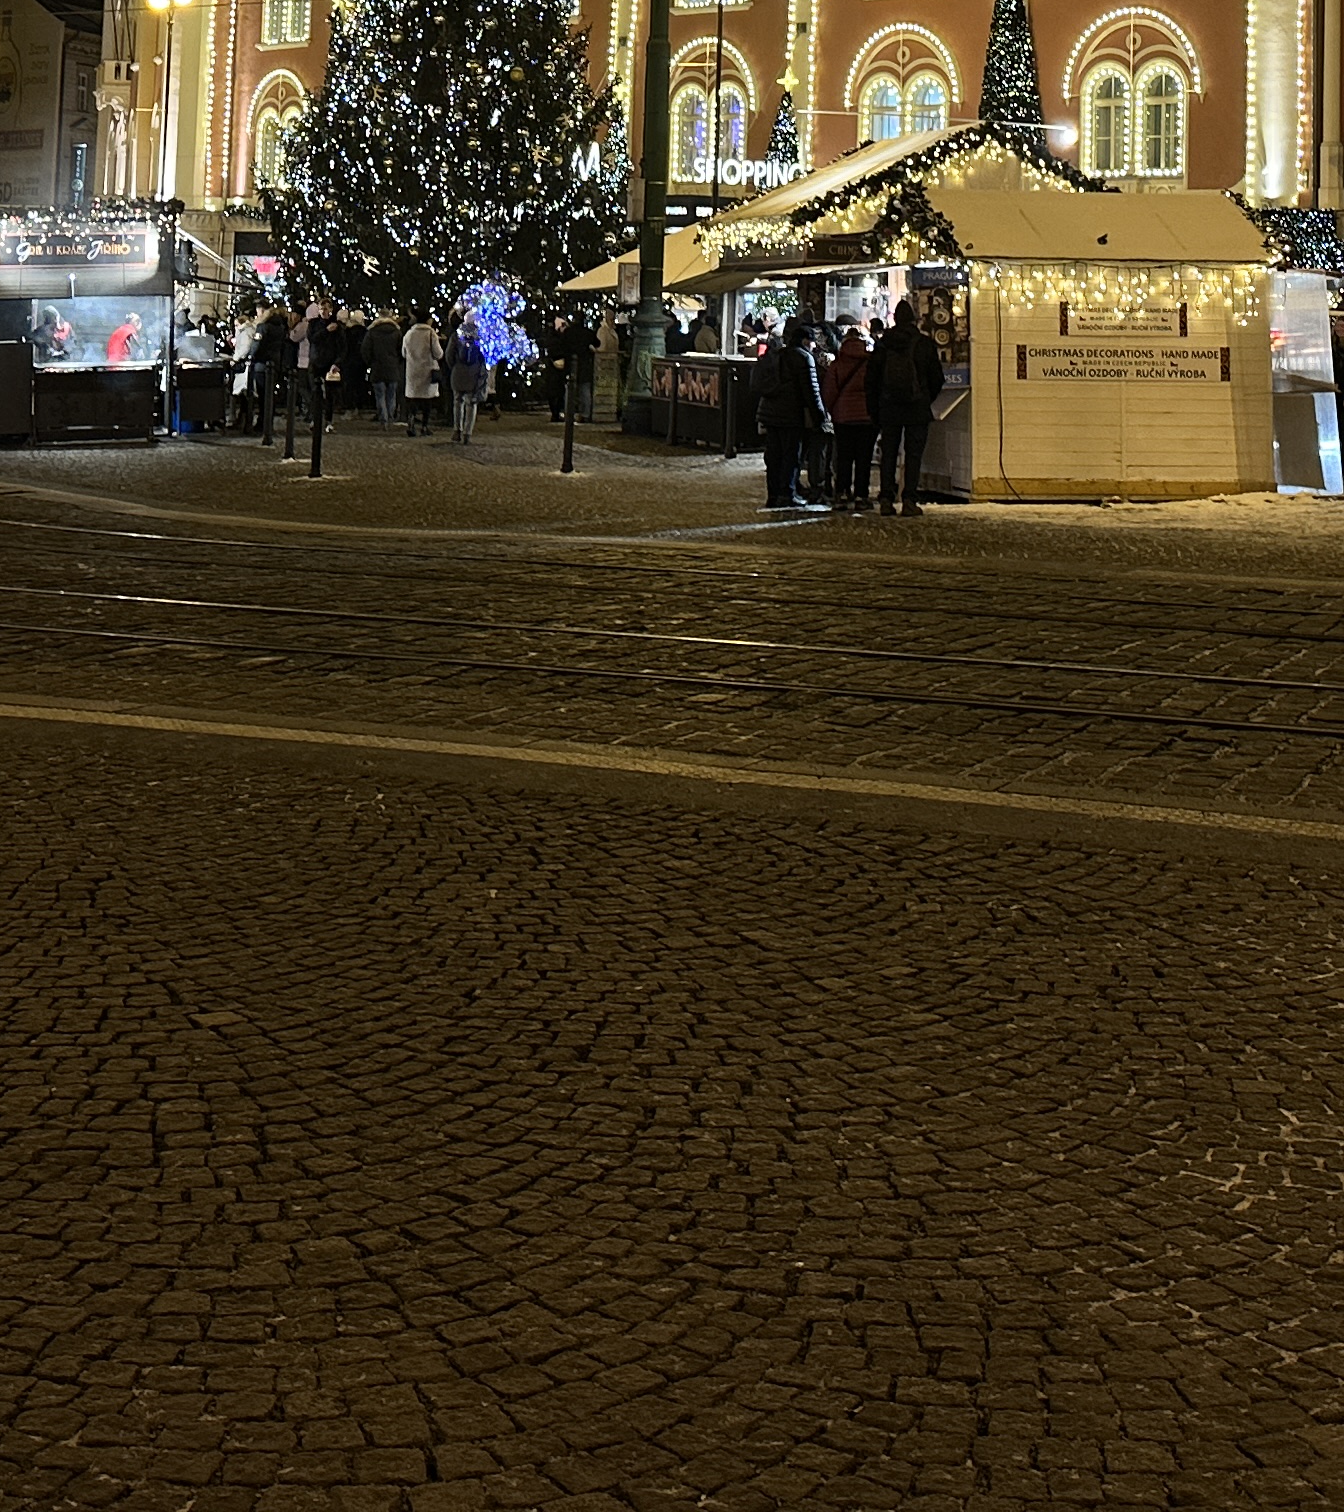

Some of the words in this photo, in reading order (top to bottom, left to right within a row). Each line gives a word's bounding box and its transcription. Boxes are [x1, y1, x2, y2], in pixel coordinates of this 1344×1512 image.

[922, 272, 961, 281] PRAGU
[1028, 349, 1085, 358] CHRISTMAS
[1087, 349, 1154, 359] DECORATIONS
[1161, 350, 1189, 359] HAND
[1191, 350, 1219, 359] MADE
[1042, 366, 1086, 378] VÁNOČNÍ
[1089, 368, 1129, 378] OZDOBY
[1136, 367, 1165, 378] RUČNÍ
[1167, 367, 1207, 378] VÝROBA
